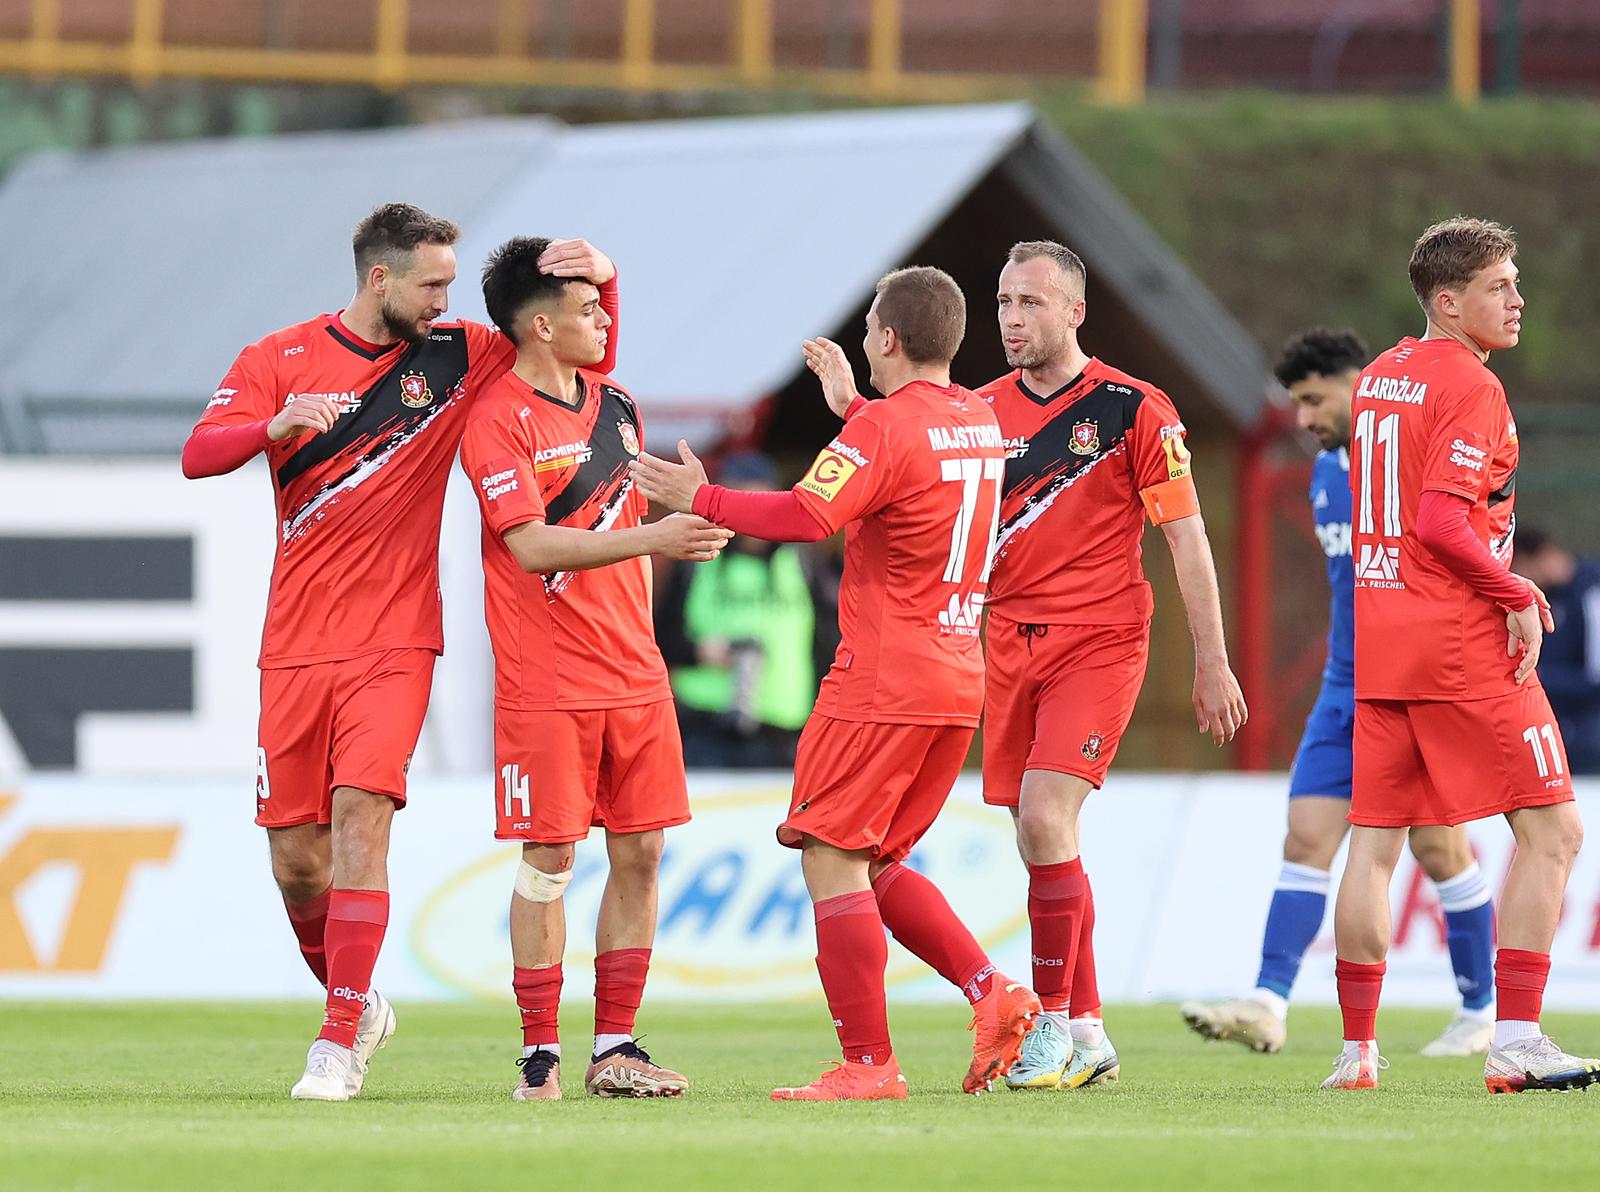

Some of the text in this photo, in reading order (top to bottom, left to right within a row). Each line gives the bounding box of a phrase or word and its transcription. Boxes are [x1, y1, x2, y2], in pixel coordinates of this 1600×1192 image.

[284, 345, 305, 357] FCG
[533, 440, 592, 465] ADMIRAL
[575, 451, 593, 464] BET
[1450, 439, 1488, 460] Super
[1449, 452, 1483, 472] Sport
[482, 468, 517, 490] Super
[1354, 409, 1402, 537] 11
[487, 479, 519, 501] Sport
[940, 458, 1005, 584] 77
[1369, 580, 1406, 590] FRISCHEIS
[1522, 723, 1564, 778] 11
[501, 764, 531, 817] 14
[1545, 779, 1564, 789] FCG
[513, 822, 532, 831] FCG
